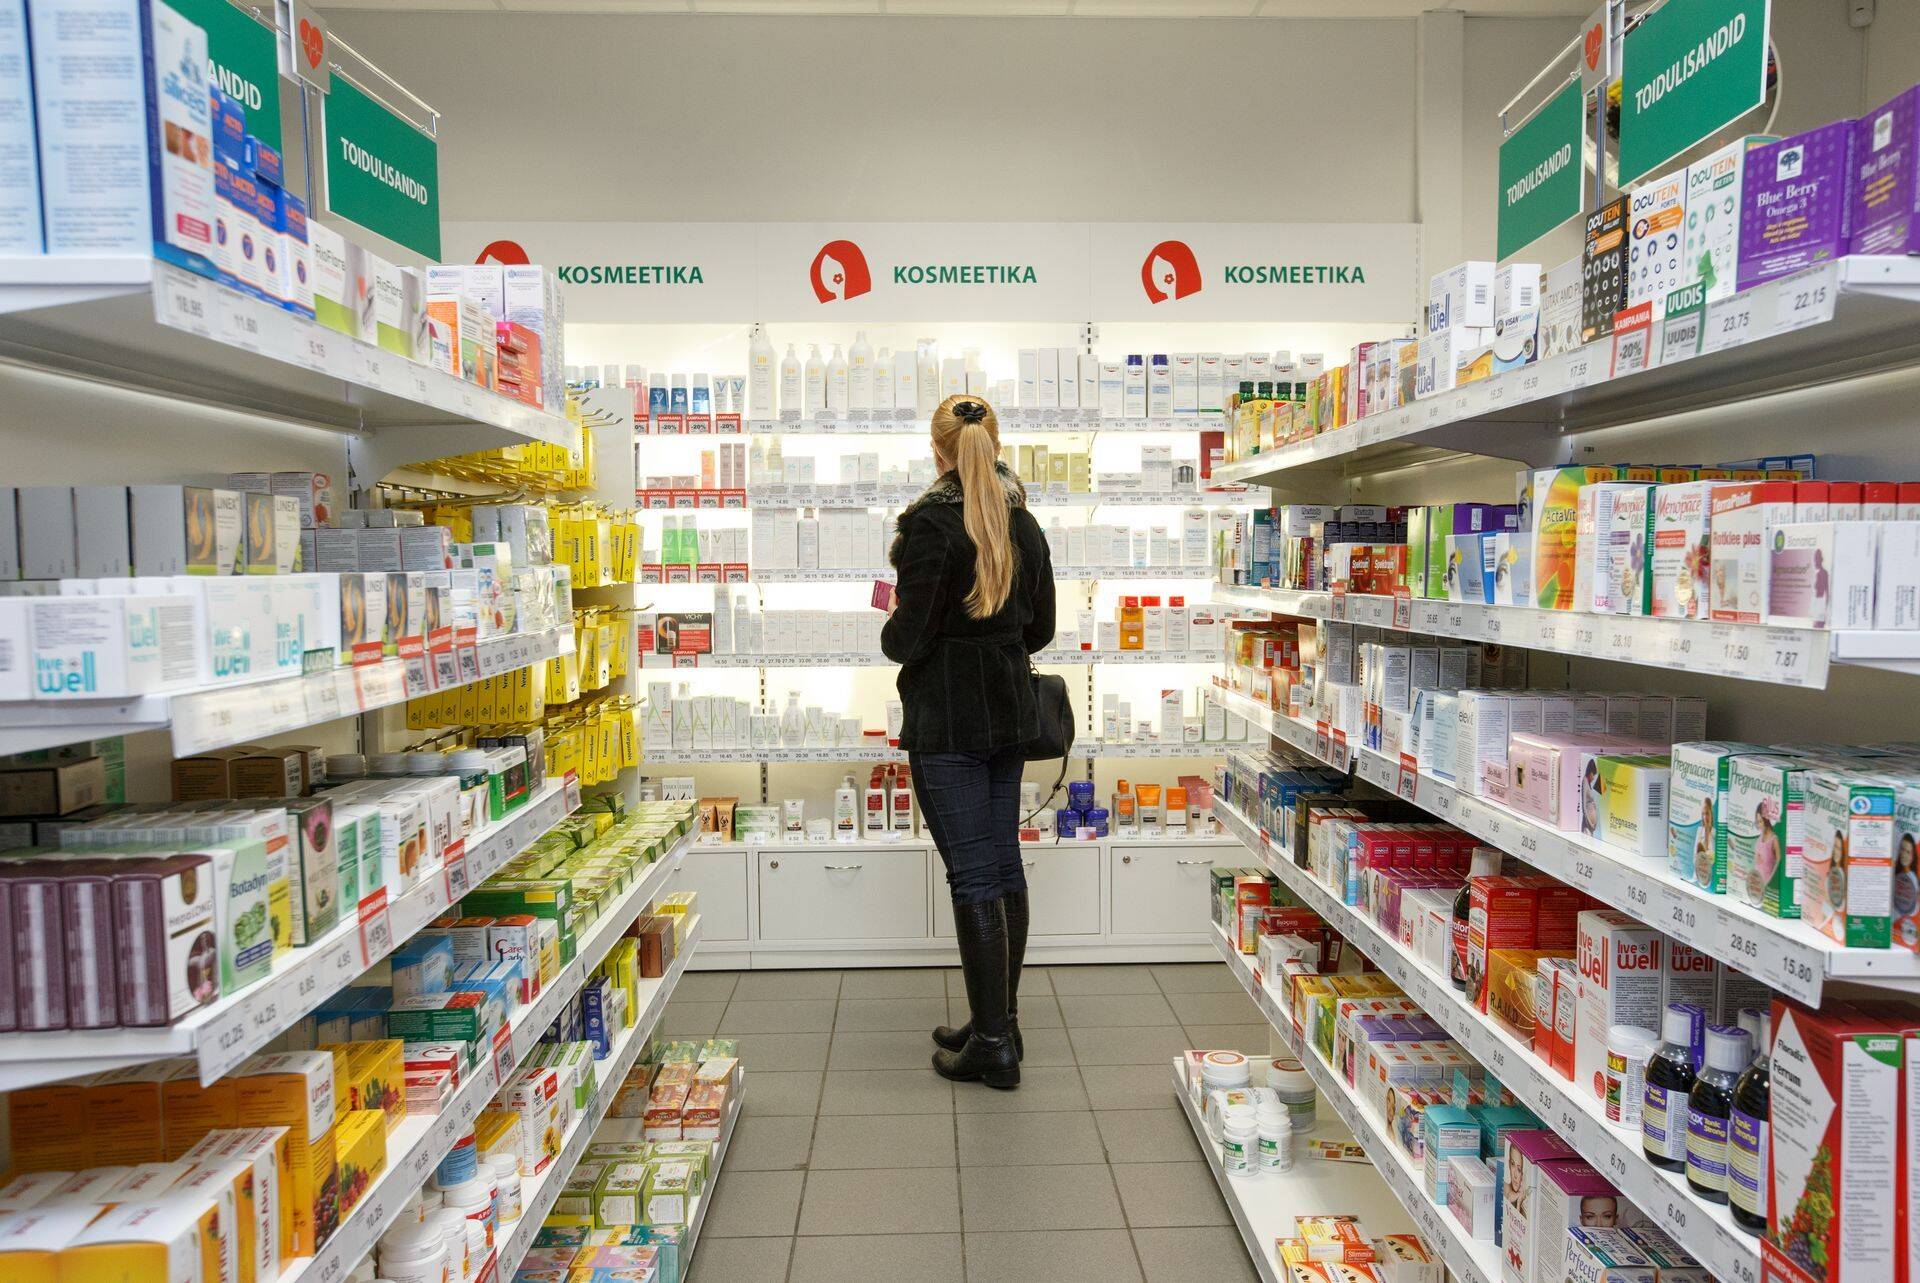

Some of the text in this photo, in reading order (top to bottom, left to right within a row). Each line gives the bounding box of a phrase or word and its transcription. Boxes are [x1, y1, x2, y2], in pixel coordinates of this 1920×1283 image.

[1635, 13, 1746, 114] TOIDULISANDID
[340, 136, 428, 206] TOIDULISANDID
[1506, 143, 1571, 208] TOIDULISANDID
[1690, 154, 1737, 188] OCUTEIN
[1632, 182, 1679, 212] OCUTEIN
[1756, 181, 1818, 208] Blue Berry
[1587, 203, 1621, 229] OCUTEIN
[557, 265, 704, 285] KOSMEETIKA
[894, 265, 1038, 284] KOSMEETIKA
[1224, 265, 1365, 284] KOSMEETIKA
[1667, 286, 1703, 313] UUDIS
[1794, 287, 1826, 311] 22.15
[1429, 292, 1450, 334] well
[1614, 306, 1650, 330] KAMPAANIA
[1722, 311, 1749, 333] 23.75
[1666, 326, 1697, 346] UUDIS
[1618, 339, 1642, 361] -20%
[1570, 362, 1587, 378] 17.55
[216, 490, 241, 512] LINEX
[276, 495, 298, 514] LINEX
[1613, 494, 1646, 520] Menopace
[1657, 493, 1702, 520] Menopace
[1545, 508, 1576, 524] ActaVit
[1743, 531, 1761, 549] plus
[365, 575, 385, 594] LINEX
[1612, 633, 1632, 648] 28.10
[36, 654, 63, 669] live
[1723, 644, 1749, 662] 17.50
[1775, 650, 1798, 669] 7.87
[37, 651, 97, 693] well
[1672, 749, 1716, 783] Pregnacare
[1728, 760, 1781, 797] Pregnacare
[1489, 821, 1500, 834] 7.95
[1521, 836, 1537, 852] 20.25
[1575, 861, 1593, 879] 12.25
[230, 872, 267, 899] Botadyn
[1627, 885, 1647, 906] 16.50
[1672, 907, 1696, 929] 28.10
[495, 938, 522, 956] Care
[1579, 921, 1593, 950] live
[1617, 940, 1638, 954] live
[1730, 933, 1757, 958] 28.65
[1617, 938, 1660, 971] well
[1671, 945, 1714, 973] well
[1672, 941, 1692, 955] live
[1578, 935, 1609, 990] well
[1782, 955, 1812, 983] 15.80
[218, 1023, 244, 1050] 12.25
[1777, 1039, 1806, 1063] Floradix
[1773, 1059, 1801, 1087] Ferrum
[1538, 1091, 1552, 1111] 5.33
[1562, 1112, 1577, 1133] 9.59
[1703, 1117, 1720, 1129] Tonic
[1703, 1125, 1726, 1139] Strong
[1735, 1117, 1752, 1131] Tonic
[1734, 1127, 1757, 1146] Strong
[1610, 1152, 1626, 1176] 6.70
[366, 1203, 384, 1230] 10.25
[1667, 1203, 1687, 1229] 6.00
[1565, 1237, 1601, 1281] Perfectil
